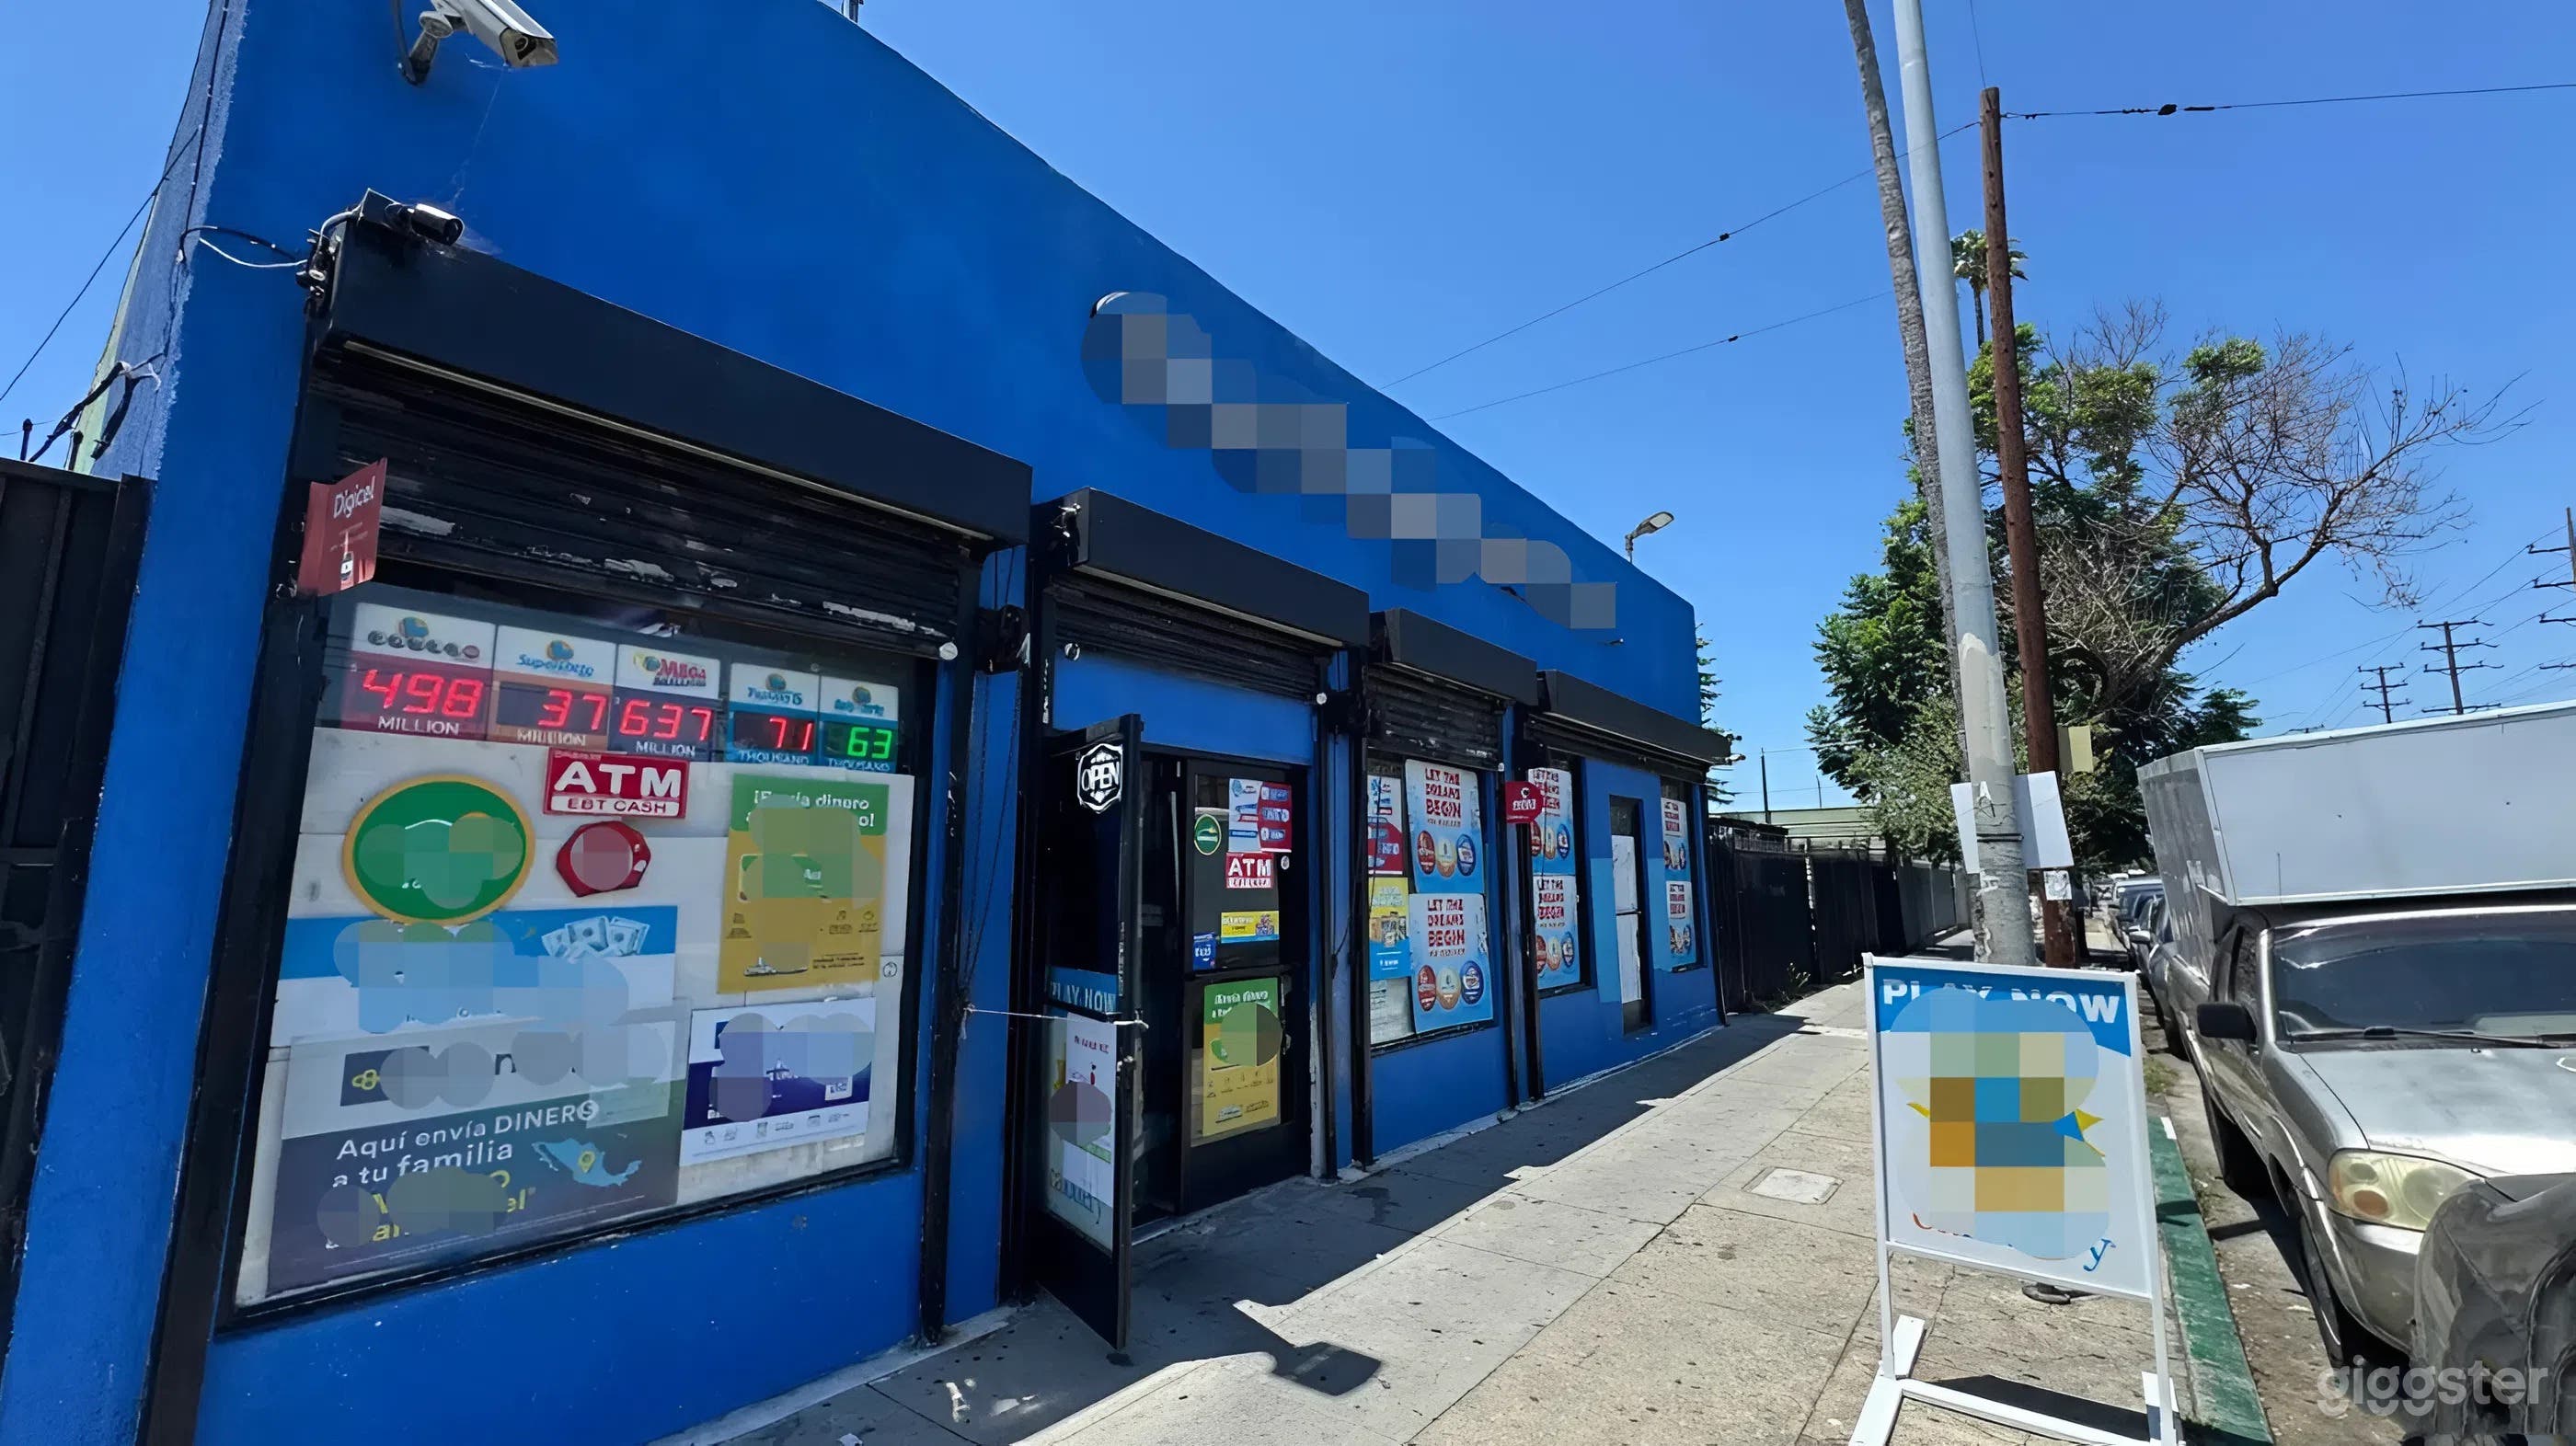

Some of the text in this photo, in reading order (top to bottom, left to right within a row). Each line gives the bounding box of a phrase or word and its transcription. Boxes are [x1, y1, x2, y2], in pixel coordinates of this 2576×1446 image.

[332, 475, 376, 519] Digicel
[362, 669, 484, 717] 498
[537, 688, 608, 732] 37
[378, 715, 459, 736] MILLION
[618, 698, 714, 742] 637
[769, 716, 813, 752] 71
[635, 740, 696, 758] MILLION
[739, 749, 810, 766] THOUSAND
[847, 726, 893, 760] 63
[554, 761, 682, 798] ATM
[1081, 761, 1121, 792] OPEN
[614, 799, 667, 814] CASH
[1228, 857, 1271, 878] ATM
[1428, 899, 1443, 912] LET
[1429, 929, 1465, 947] BEGIN
[337, 1131, 408, 1160] Aquí
[414, 1120, 487, 1148] envía
[332, 1140, 513, 1188] a tu familia
